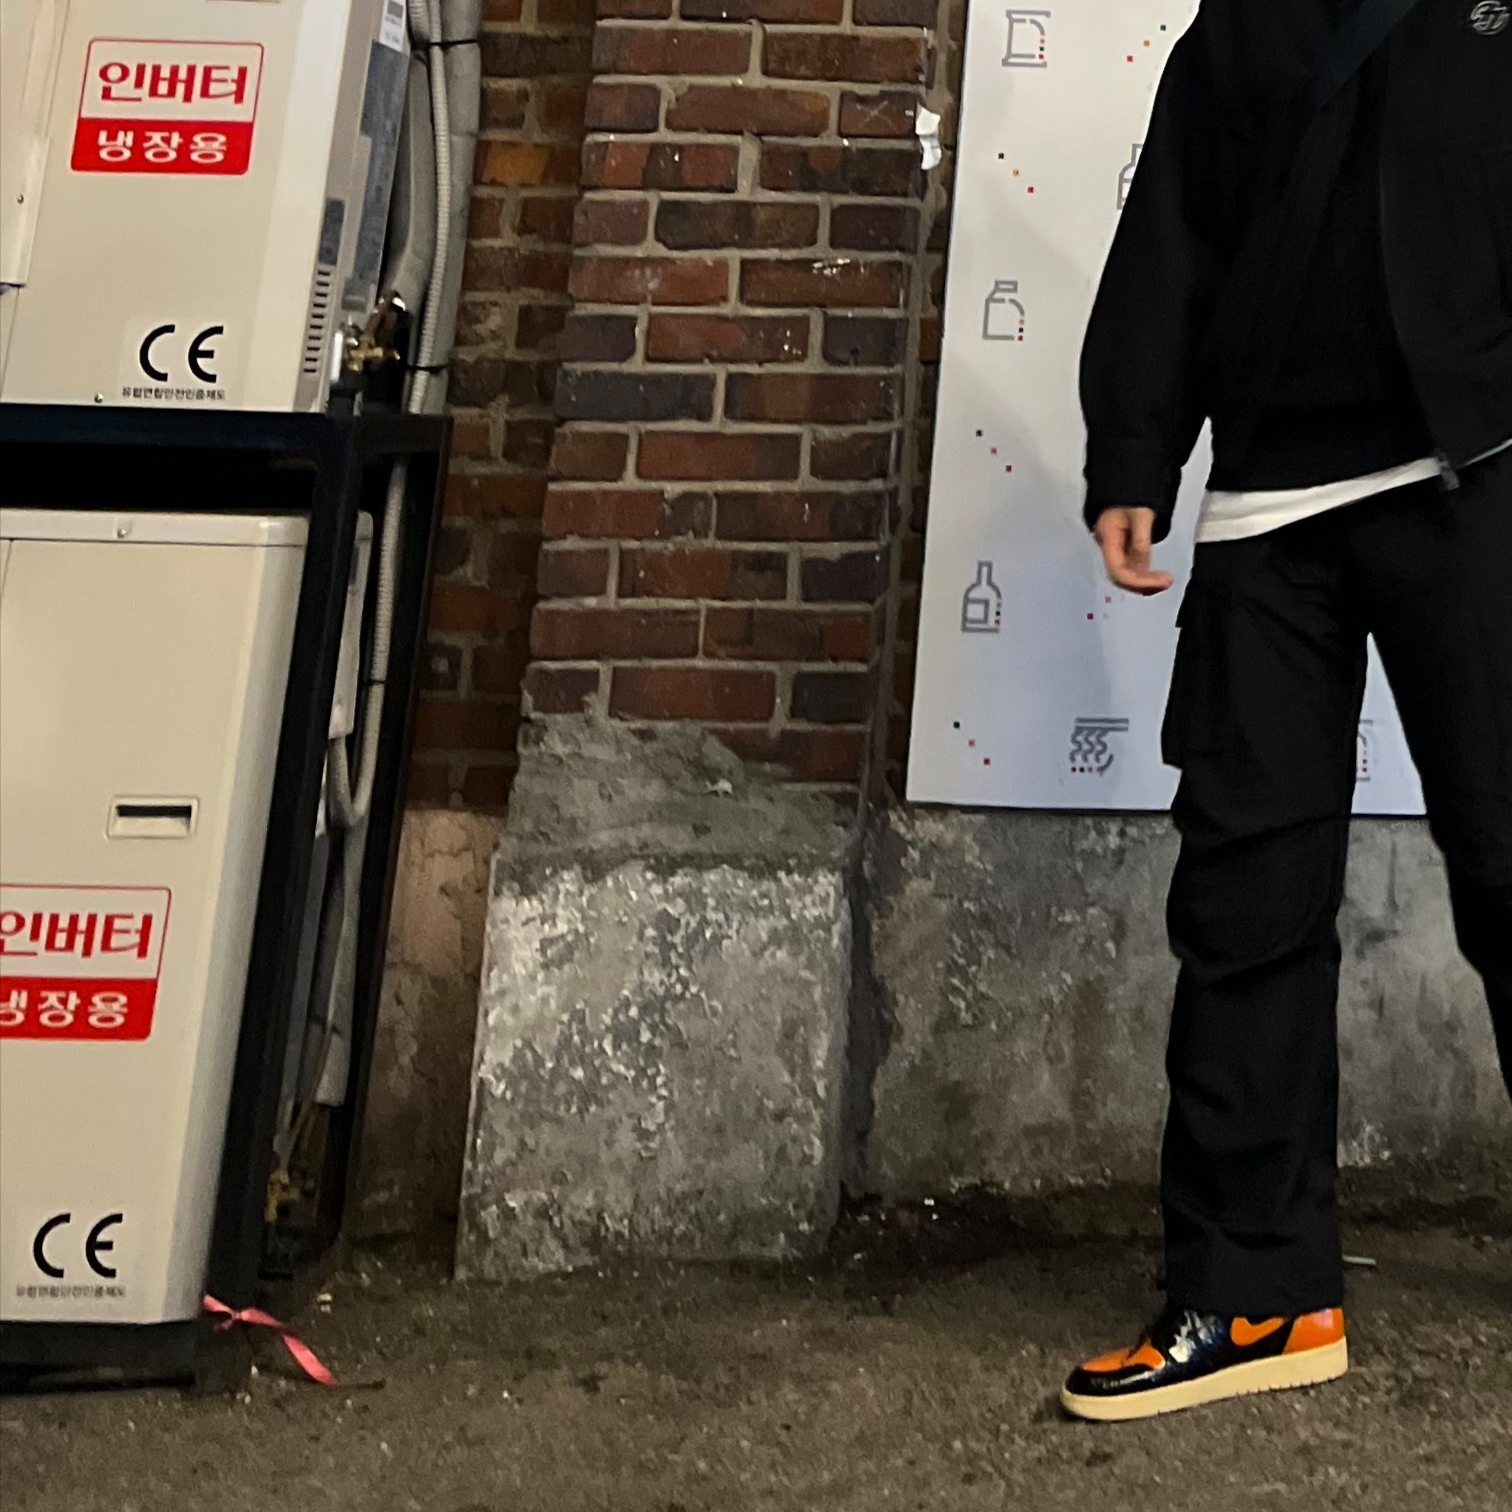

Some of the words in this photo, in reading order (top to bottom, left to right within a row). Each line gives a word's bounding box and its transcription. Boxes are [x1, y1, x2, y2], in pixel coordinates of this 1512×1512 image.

[98, 60, 248, 105] 인버터
[97, 129, 227, 165] 냉장용
[139, 323, 224, 384] CE
[0, 911, 153, 959] 인버터
[32, 1212, 123, 1279] CE
